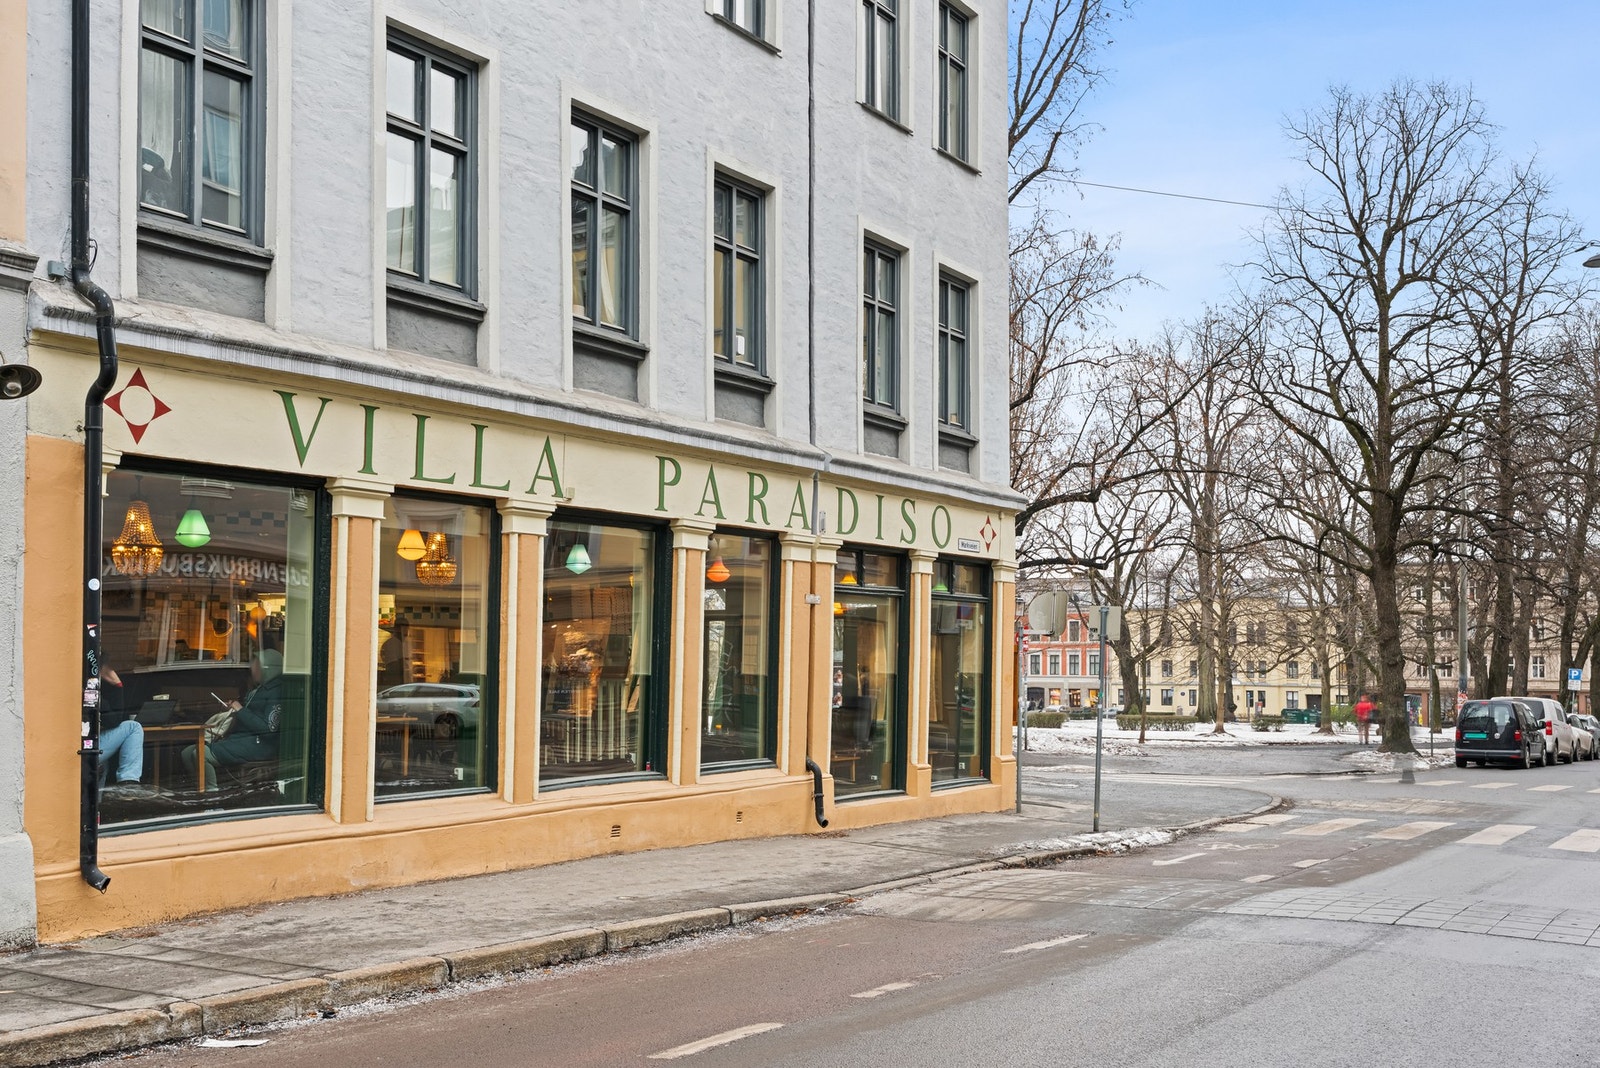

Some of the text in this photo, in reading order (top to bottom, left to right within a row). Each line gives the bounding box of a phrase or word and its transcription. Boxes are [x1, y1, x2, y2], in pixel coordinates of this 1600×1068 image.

[274, 389, 952, 549] VILLA PARADISO
[1571, 670, 1579, 679] P
